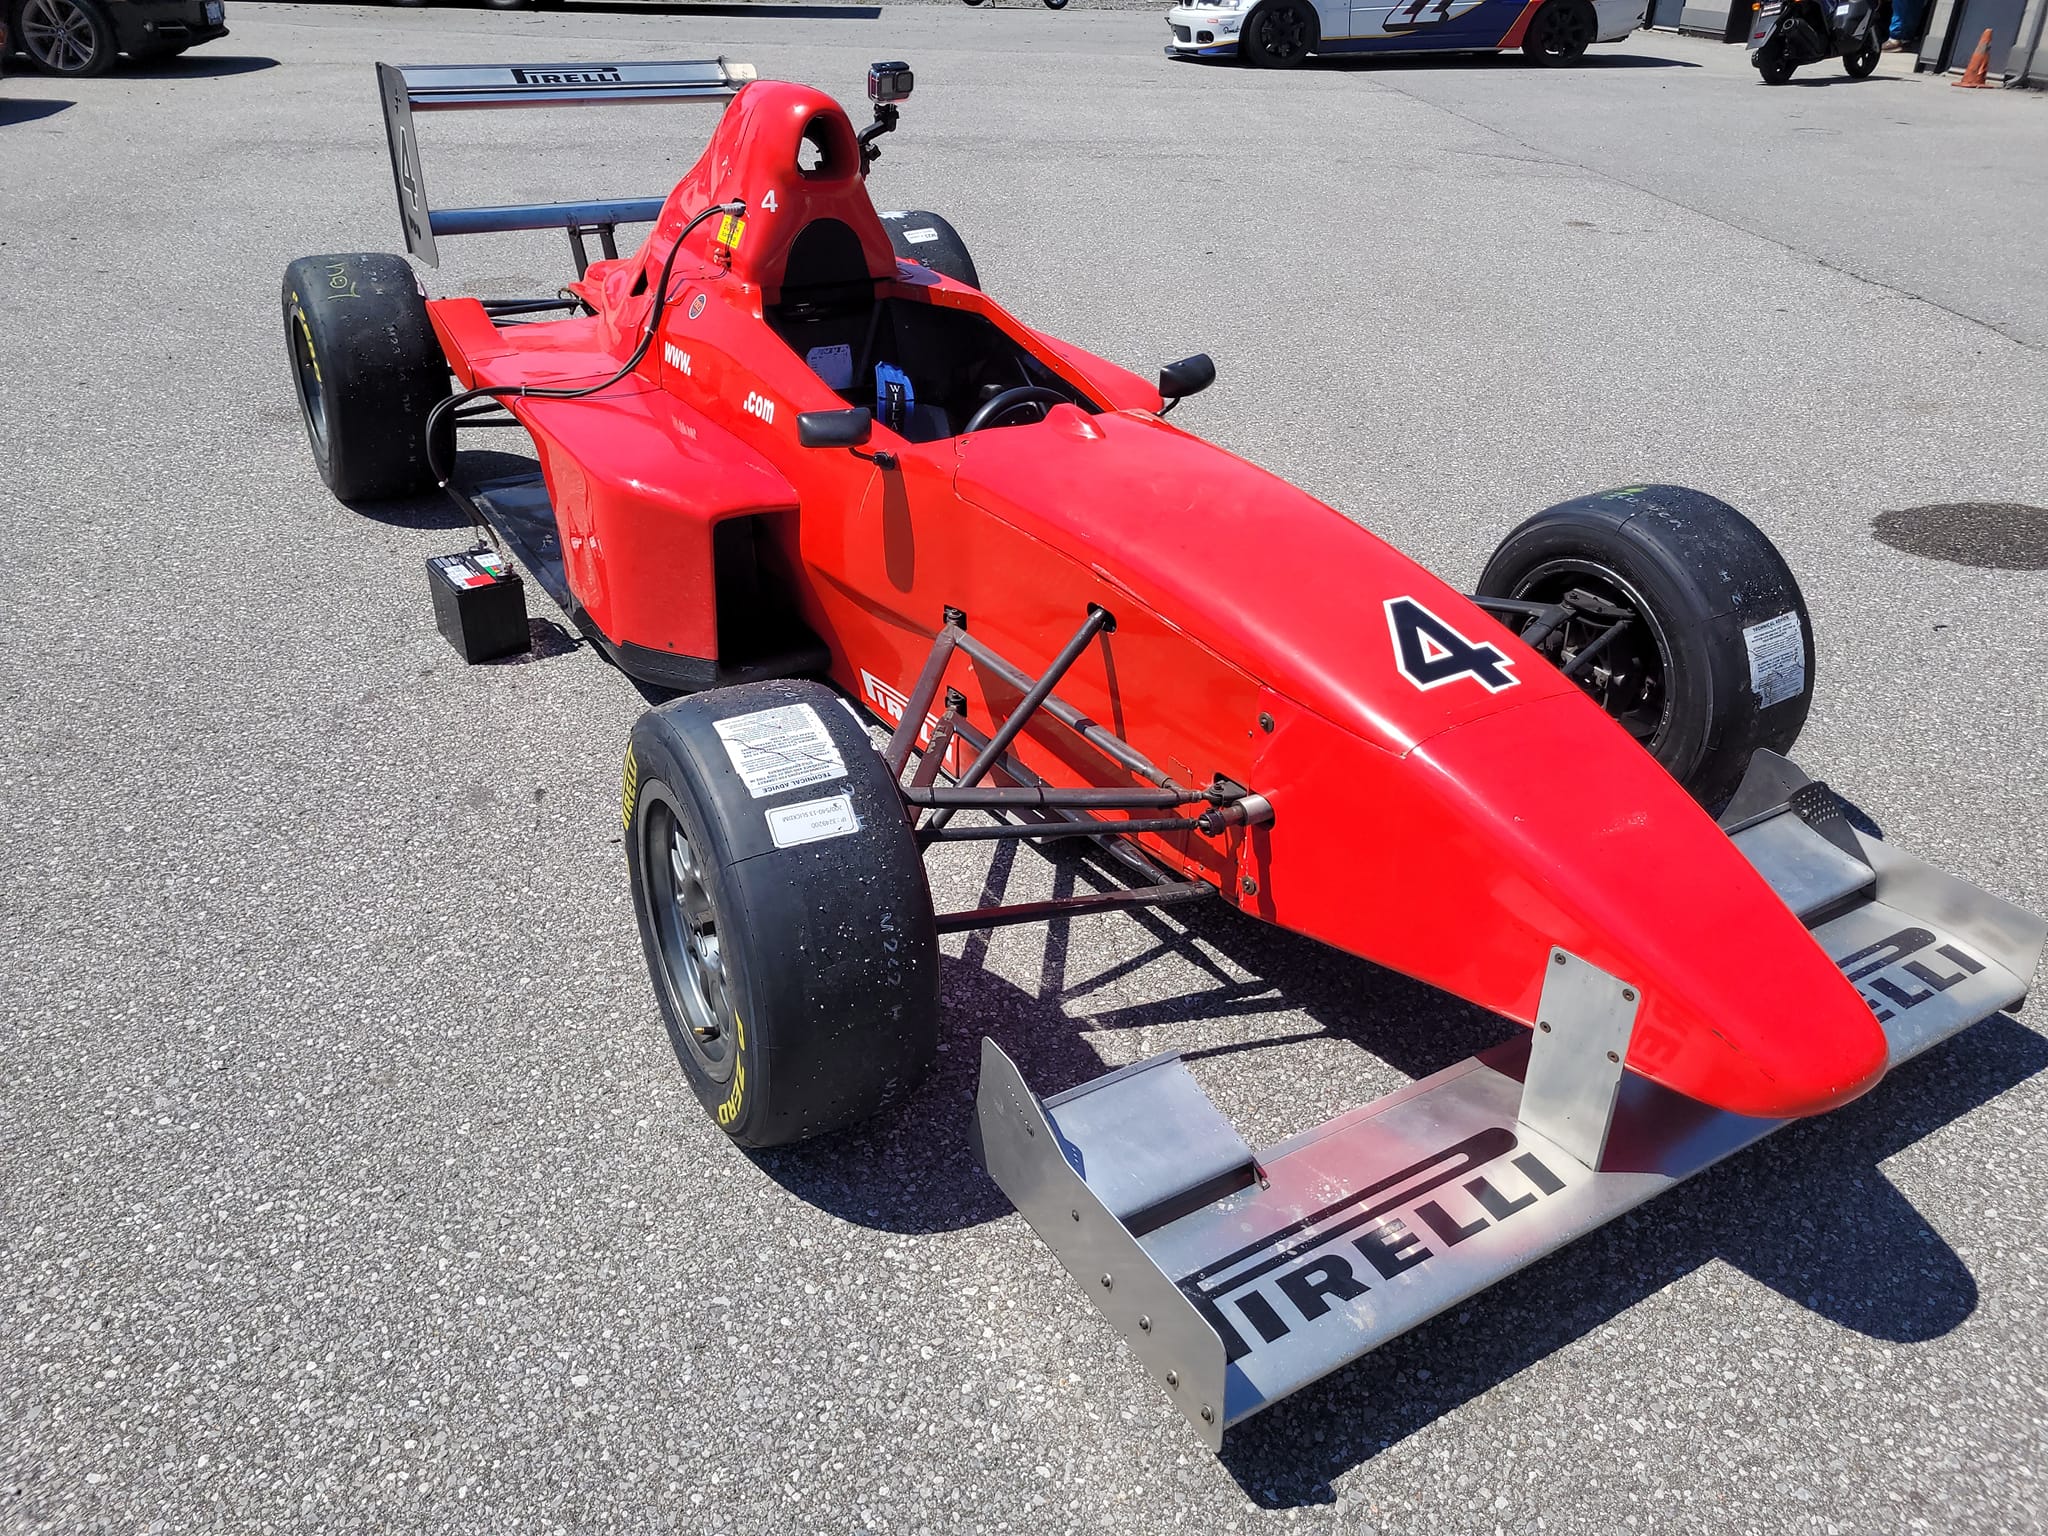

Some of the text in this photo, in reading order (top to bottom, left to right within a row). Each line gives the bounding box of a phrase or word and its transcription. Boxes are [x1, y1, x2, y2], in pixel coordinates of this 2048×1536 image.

[510, 67, 622, 84] PIRELLI
[400, 126, 419, 213] 4
[760, 189, 779, 213] 4
[664, 341, 692, 377] www.
[743, 390, 775, 425] .com
[1384, 597, 1520, 692] 4
[760, 771, 832, 793] TECHNICAL ADVICE
[1177, 1127, 1566, 1365] PIRELLI
